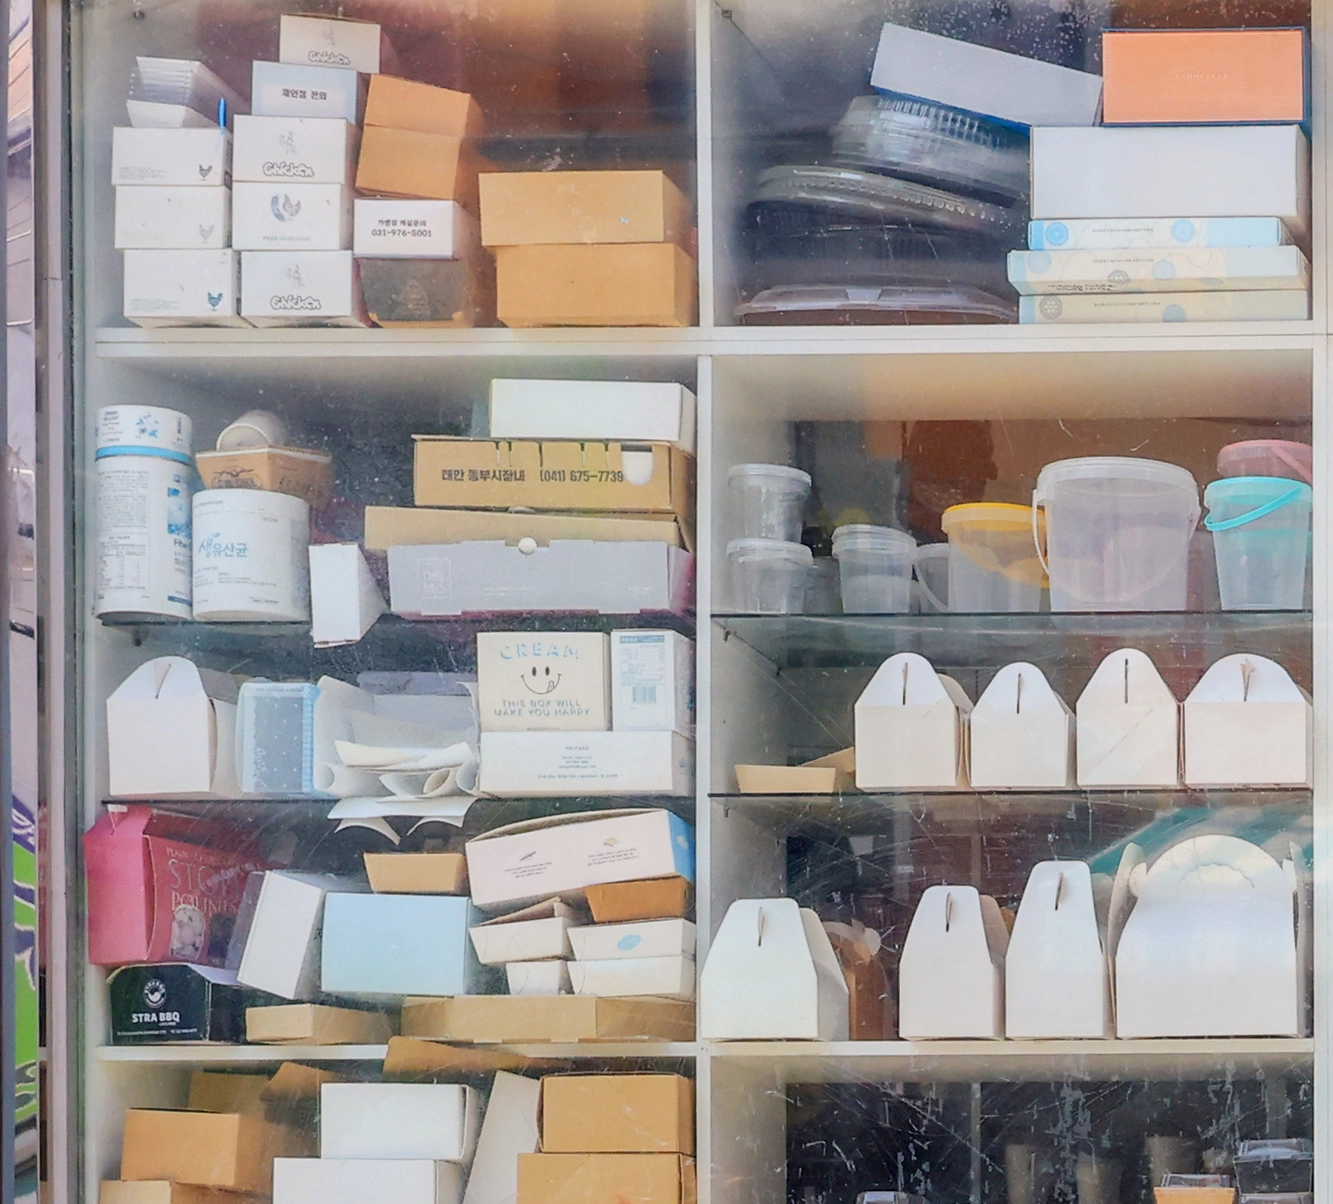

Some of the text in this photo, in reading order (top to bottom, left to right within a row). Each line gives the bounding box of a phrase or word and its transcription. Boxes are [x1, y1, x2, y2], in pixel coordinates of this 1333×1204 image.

[263, 161, 315, 178] Chicken
[371, 228, 432, 238] 031-976-5001
[270, 295, 322, 311] Chicken
[441, 468, 465, 482] 태안
[540, 469, 567, 483] (041)
[569, 469, 624, 483] 675-7739
[198, 532, 249, 558] 생유산균
[499, 642, 579, 660] CREAM
[501, 699, 581, 708] THIS BOX WILL
[494, 708, 590, 718] MAKE YOU HAPPY
[132, 1011, 181, 1023] STRA BBQ
